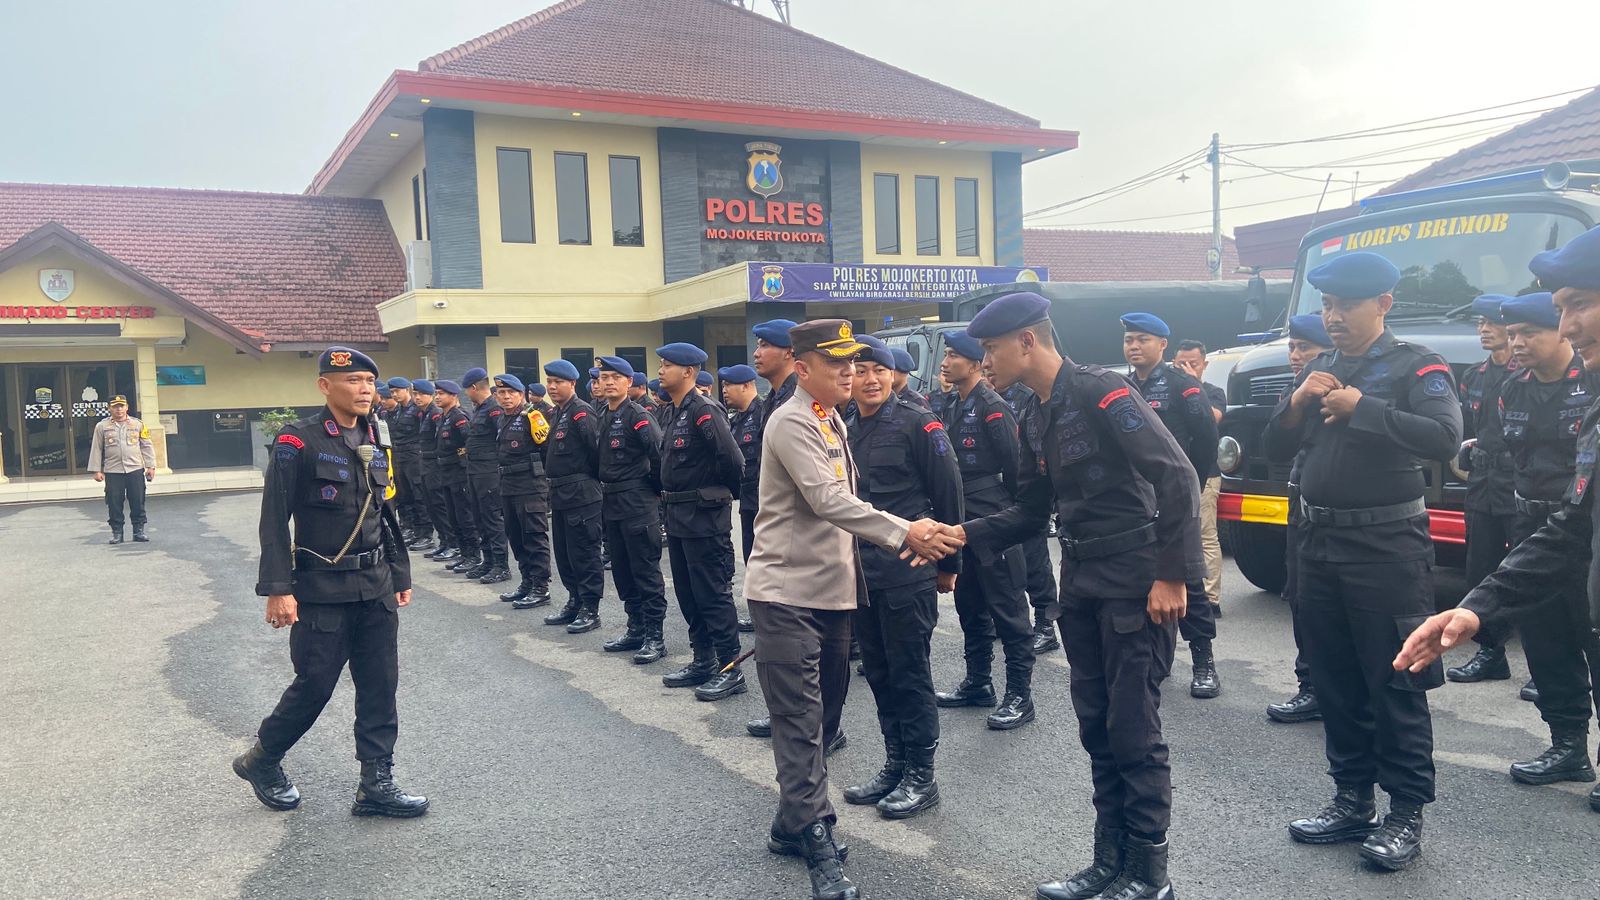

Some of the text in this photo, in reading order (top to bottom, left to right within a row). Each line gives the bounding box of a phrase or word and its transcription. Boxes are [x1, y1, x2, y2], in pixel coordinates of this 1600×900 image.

[706, 197, 824, 226] POLRES
[1346, 212, 1510, 251] KORPS BRIMOB
[833, 267, 978, 283] POLRES MOJOKERTO KOTA
[813, 282, 838, 291] SIAP
[840, 282, 880, 291] MENUJU
[882, 282, 908, 291] ZONA
[911, 283, 966, 291] INTEGRITAS
[829, 290, 864, 298] (WILAYAH
[905, 291, 930, 299] BERSIH
[76, 305, 156, 319] CENTER
[73, 401, 108, 409] CENTER
